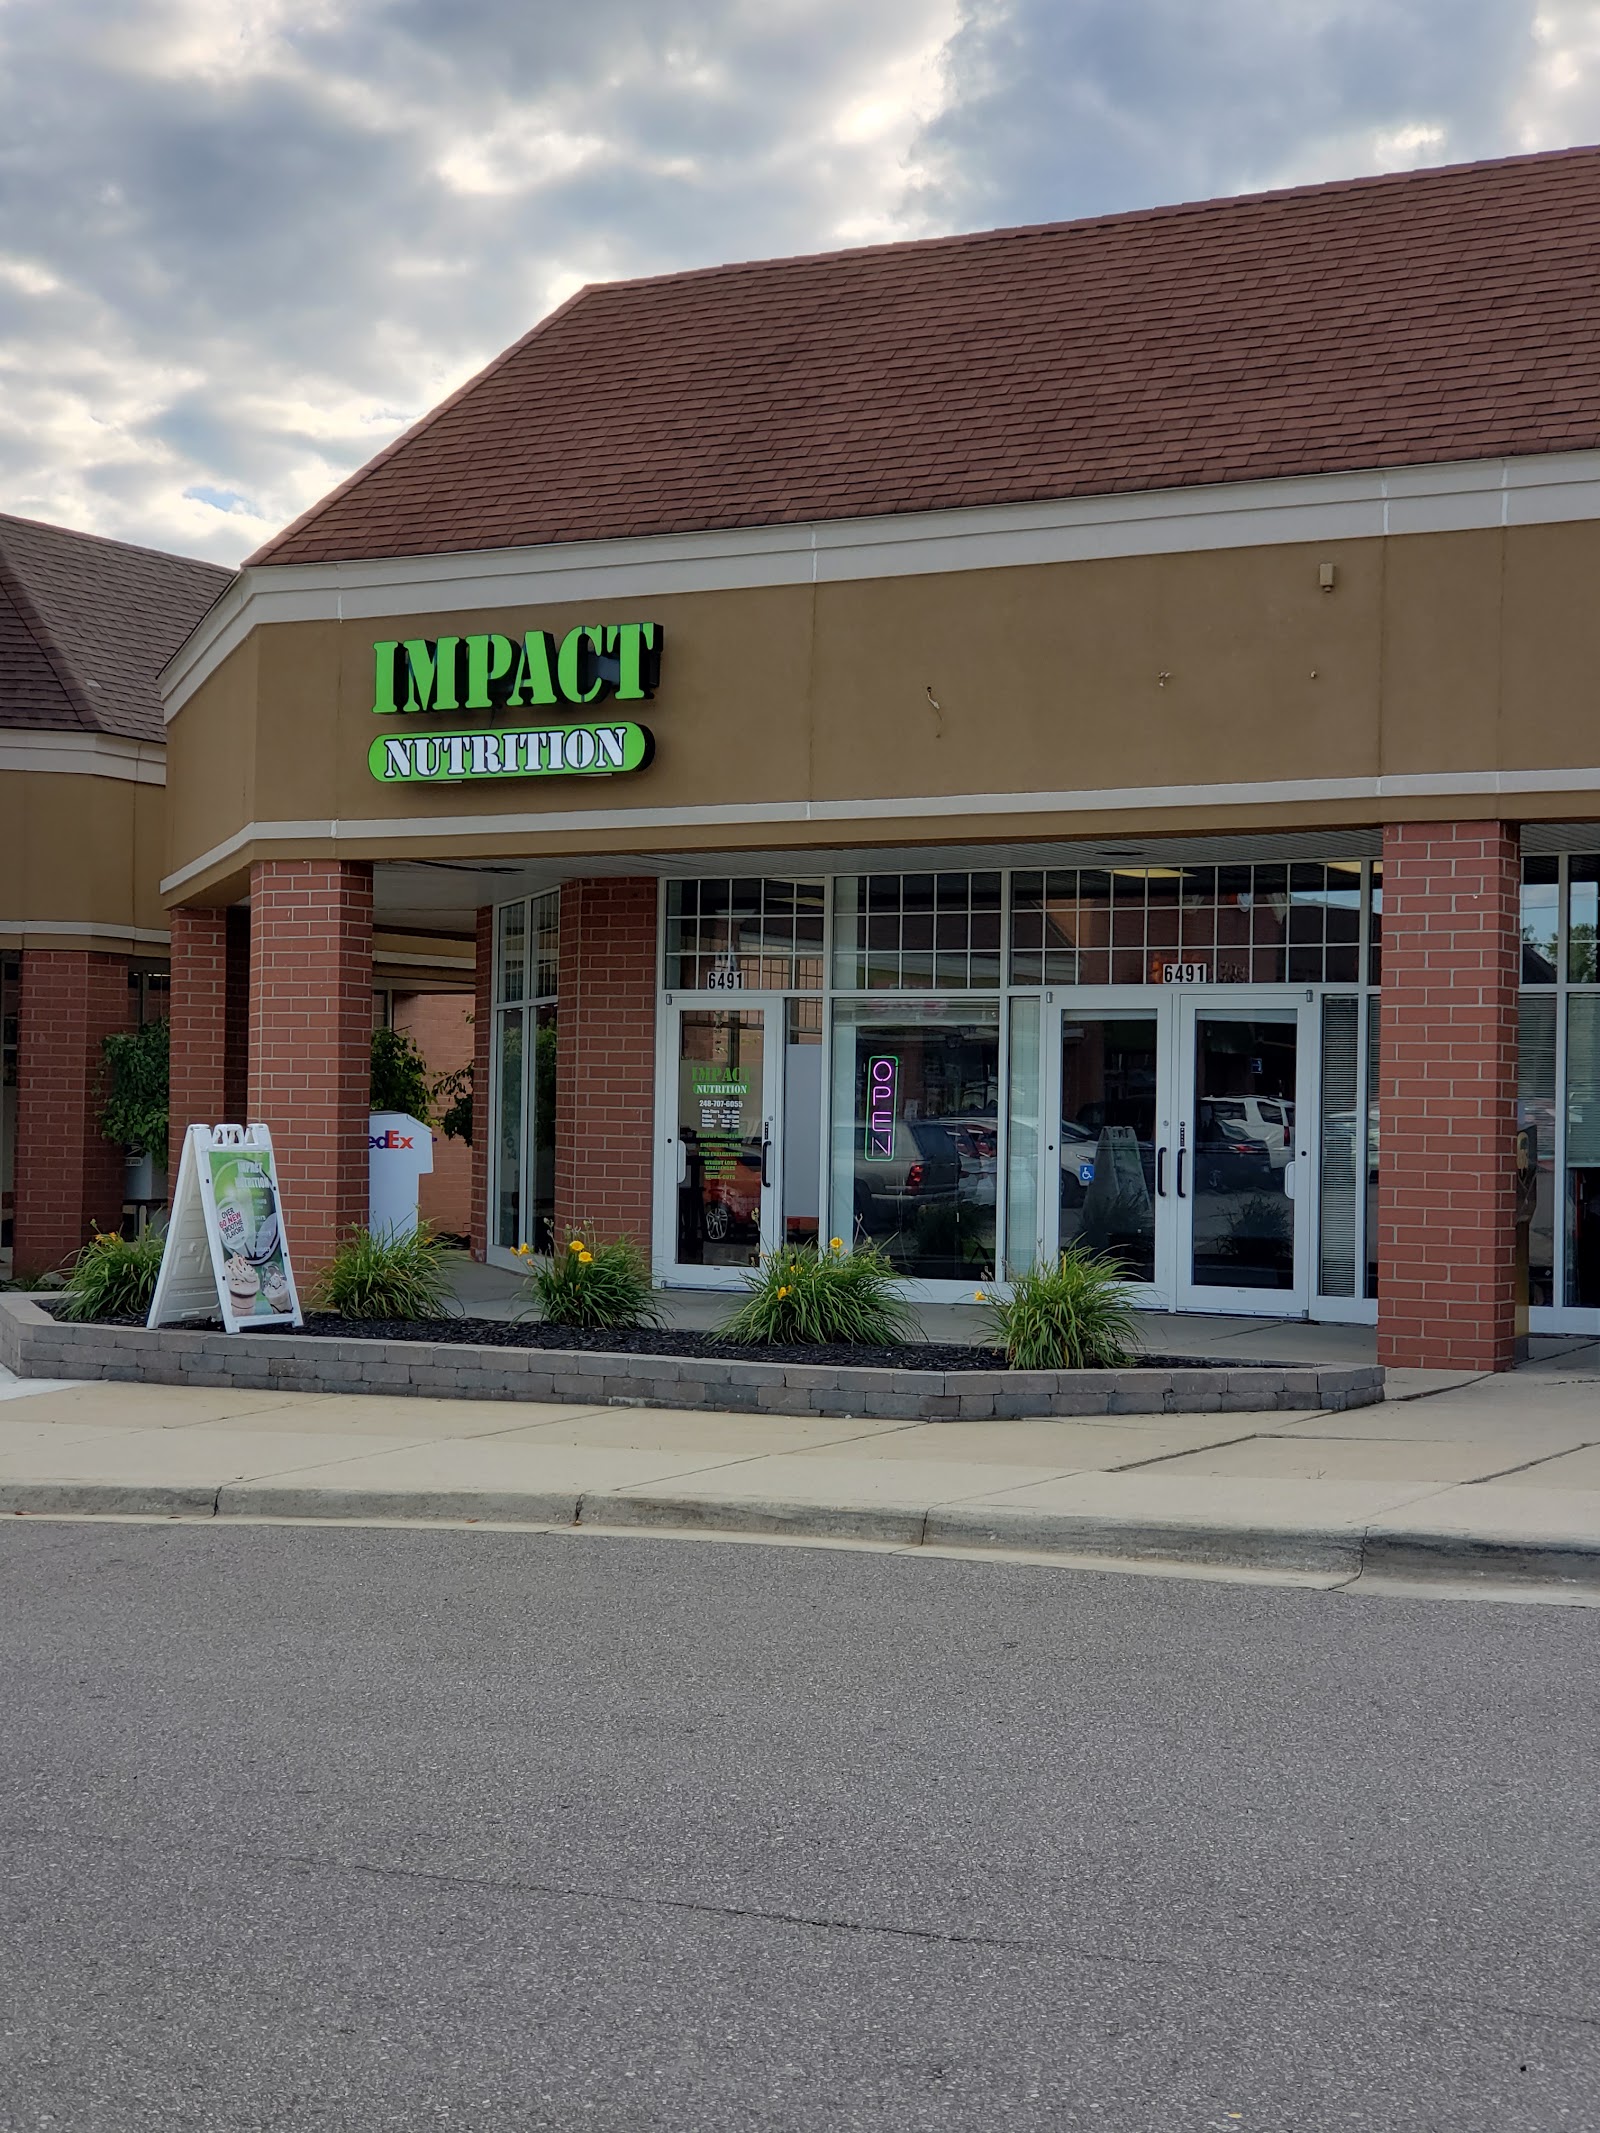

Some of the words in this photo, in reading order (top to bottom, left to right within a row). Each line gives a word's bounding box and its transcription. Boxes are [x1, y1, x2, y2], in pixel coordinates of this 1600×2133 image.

[372, 622, 655, 713] IMPACT
[384, 728, 627, 777] NUTRITION
[708, 972, 742, 989] 6491
[1164, 964, 1204, 982] 6491
[692, 1066, 750, 1082] IMPACT
[696, 1084, 748, 1094] NUTRITION
[871, 1060, 893, 1156] OPEN
[368, 1130, 414, 1149] edEx
[222, 1207, 234, 1218] OVER
[227, 1211, 242, 1224] NEW
